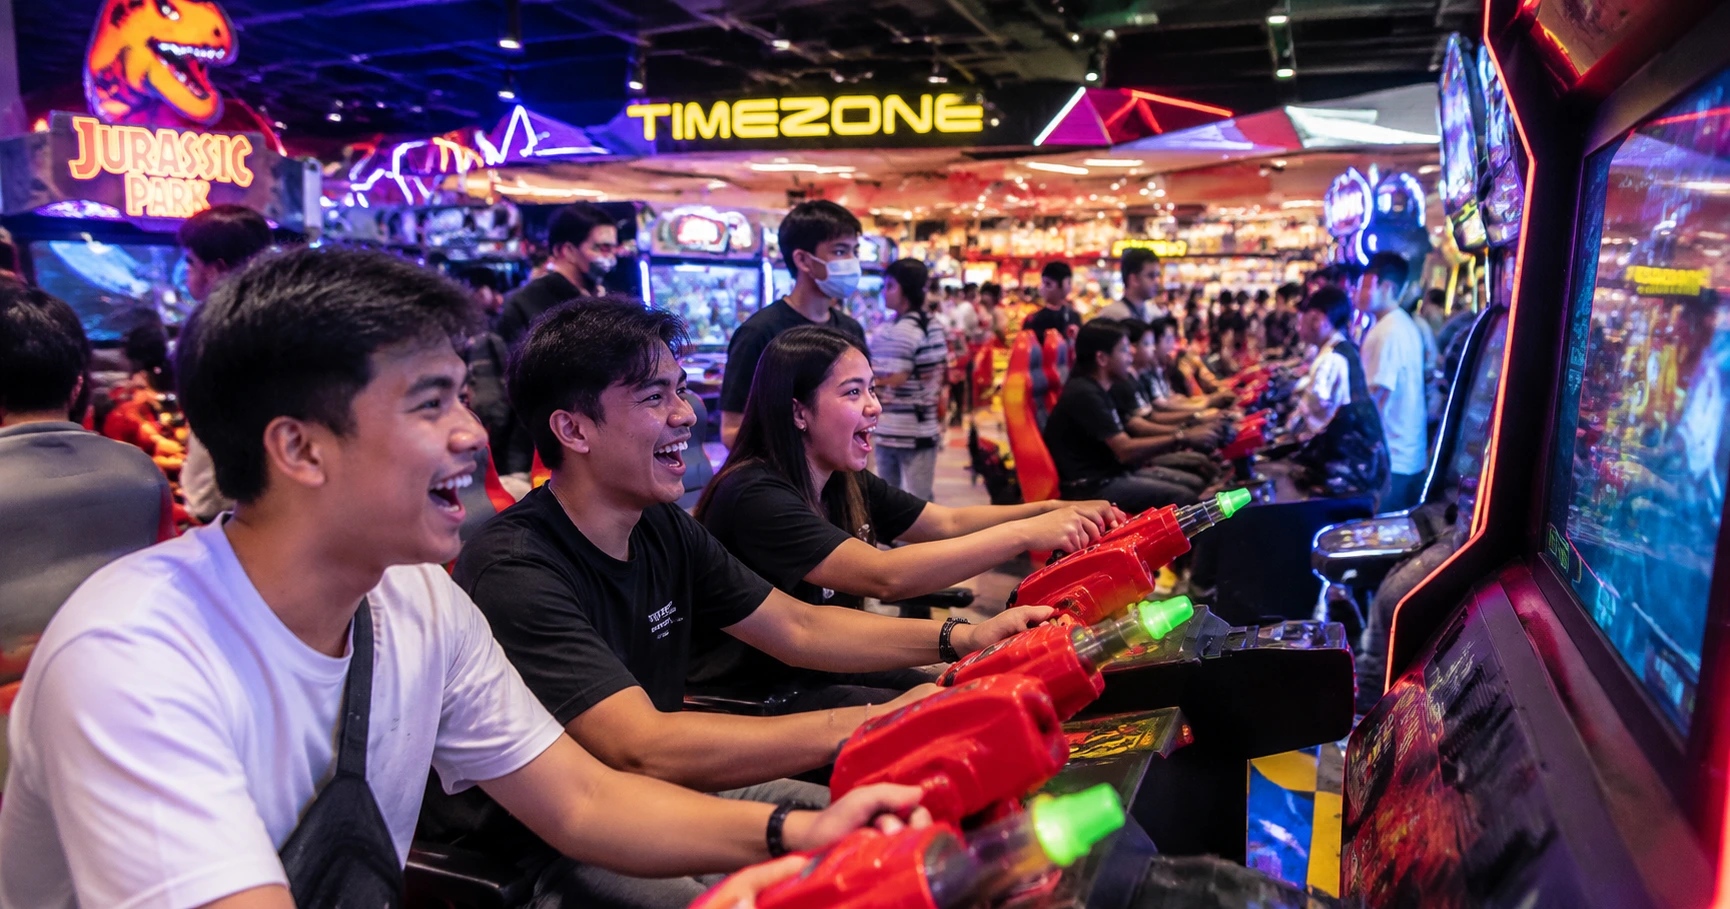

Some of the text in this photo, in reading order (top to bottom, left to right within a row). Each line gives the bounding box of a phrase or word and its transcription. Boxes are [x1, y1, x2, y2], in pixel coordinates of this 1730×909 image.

[627, 94, 984, 141] TIMEZONE
[68, 116, 254, 188] JURASSIC
[125, 171, 211, 218] PARK
